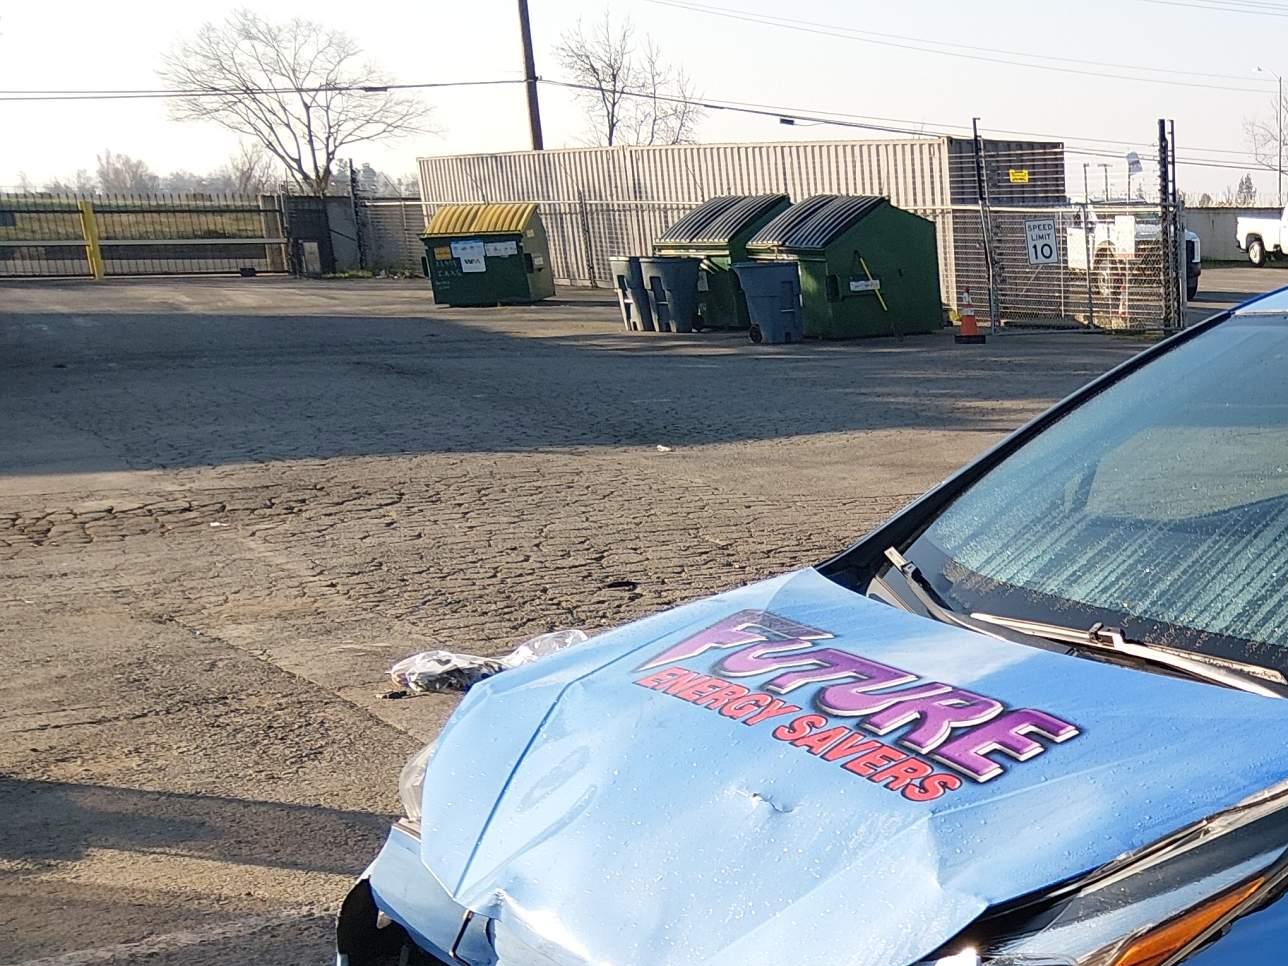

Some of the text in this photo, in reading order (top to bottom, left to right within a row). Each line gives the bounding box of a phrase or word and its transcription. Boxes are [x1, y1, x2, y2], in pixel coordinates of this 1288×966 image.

[1032, 243, 1053, 260] 10
[632, 609, 1080, 783] FUTURE
[632, 667, 964, 802] ENERGY SAVERS
